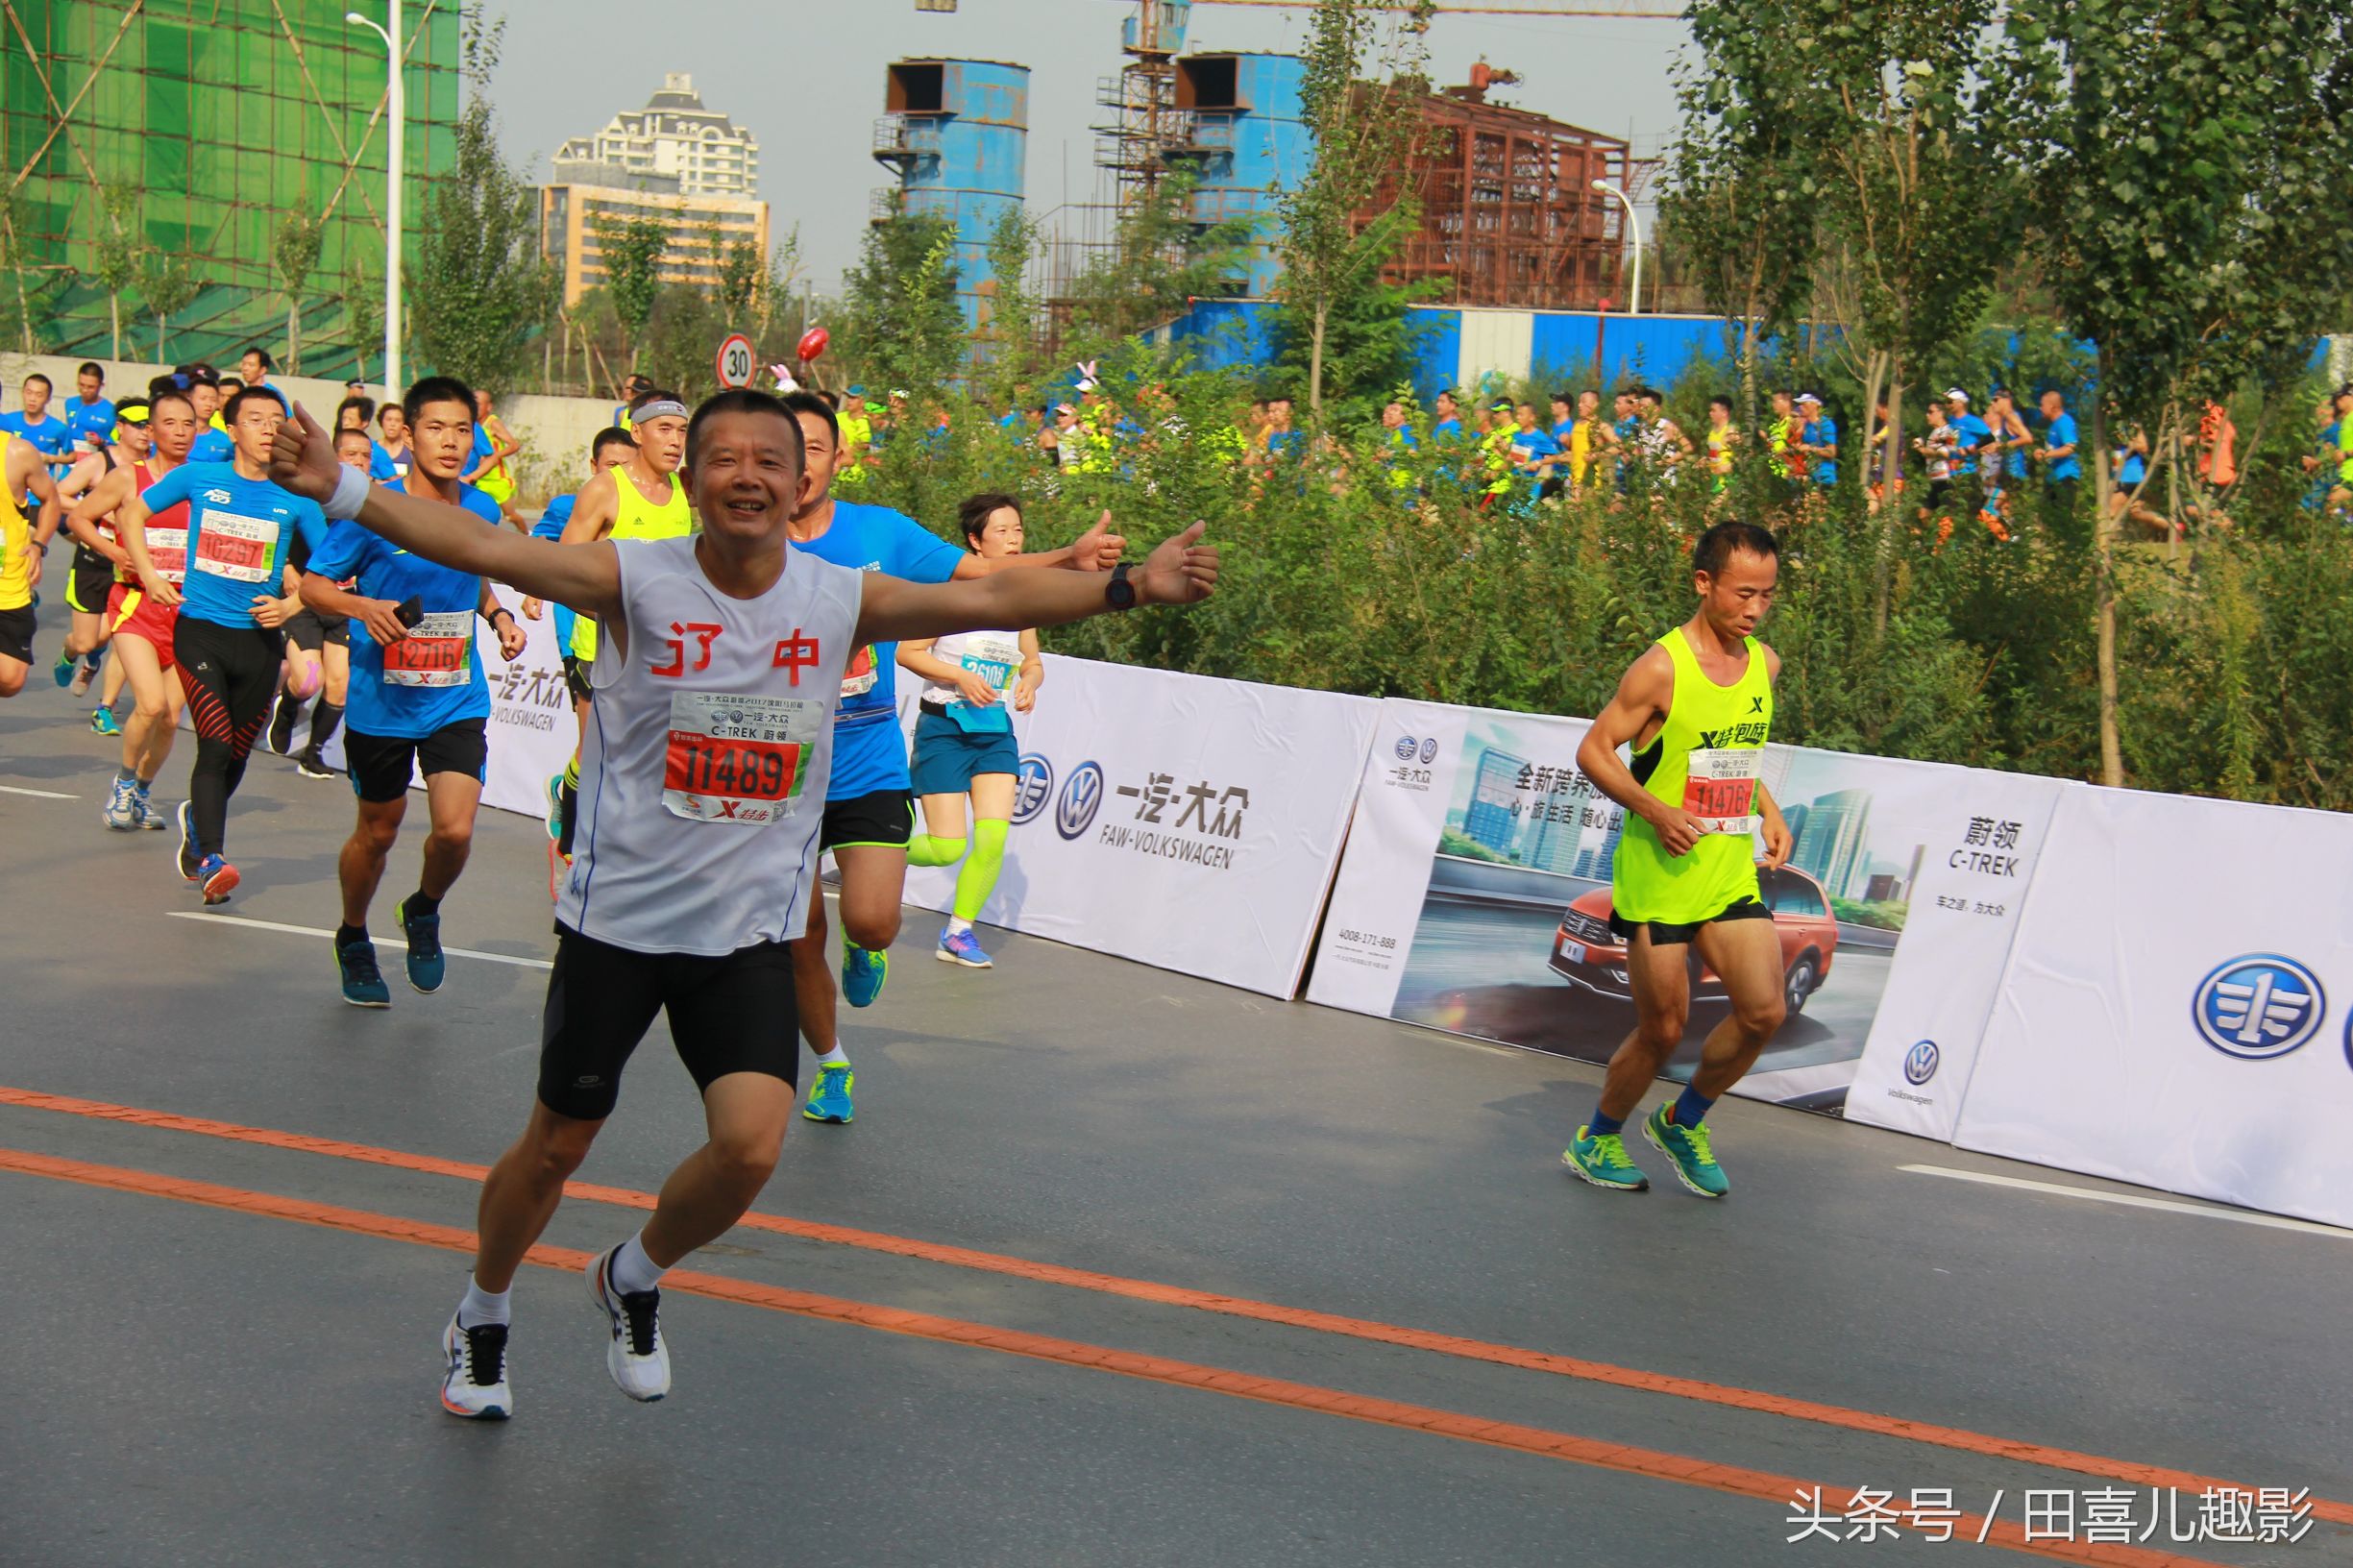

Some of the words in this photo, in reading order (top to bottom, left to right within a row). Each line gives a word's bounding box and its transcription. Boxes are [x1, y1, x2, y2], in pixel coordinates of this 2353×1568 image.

[727, 350, 748, 378] 30
[204, 536, 258, 566] 10297
[398, 643, 455, 669] 12716
[711, 725, 757, 739] C-TREK
[685, 747, 783, 796] 11489
[1116, 772, 1249, 840] 一汽·大众
[1697, 784, 1746, 815] 11476
[1099, 823, 1235, 870] FAW-VOLKSWAGEN
[1964, 816, 2022, 850] 蔚领
[1949, 849, 2020, 877] C-TREK
[1338, 928, 1396, 949] 4008-171-888
[1887, 1088, 1934, 1105] Volkswagen
